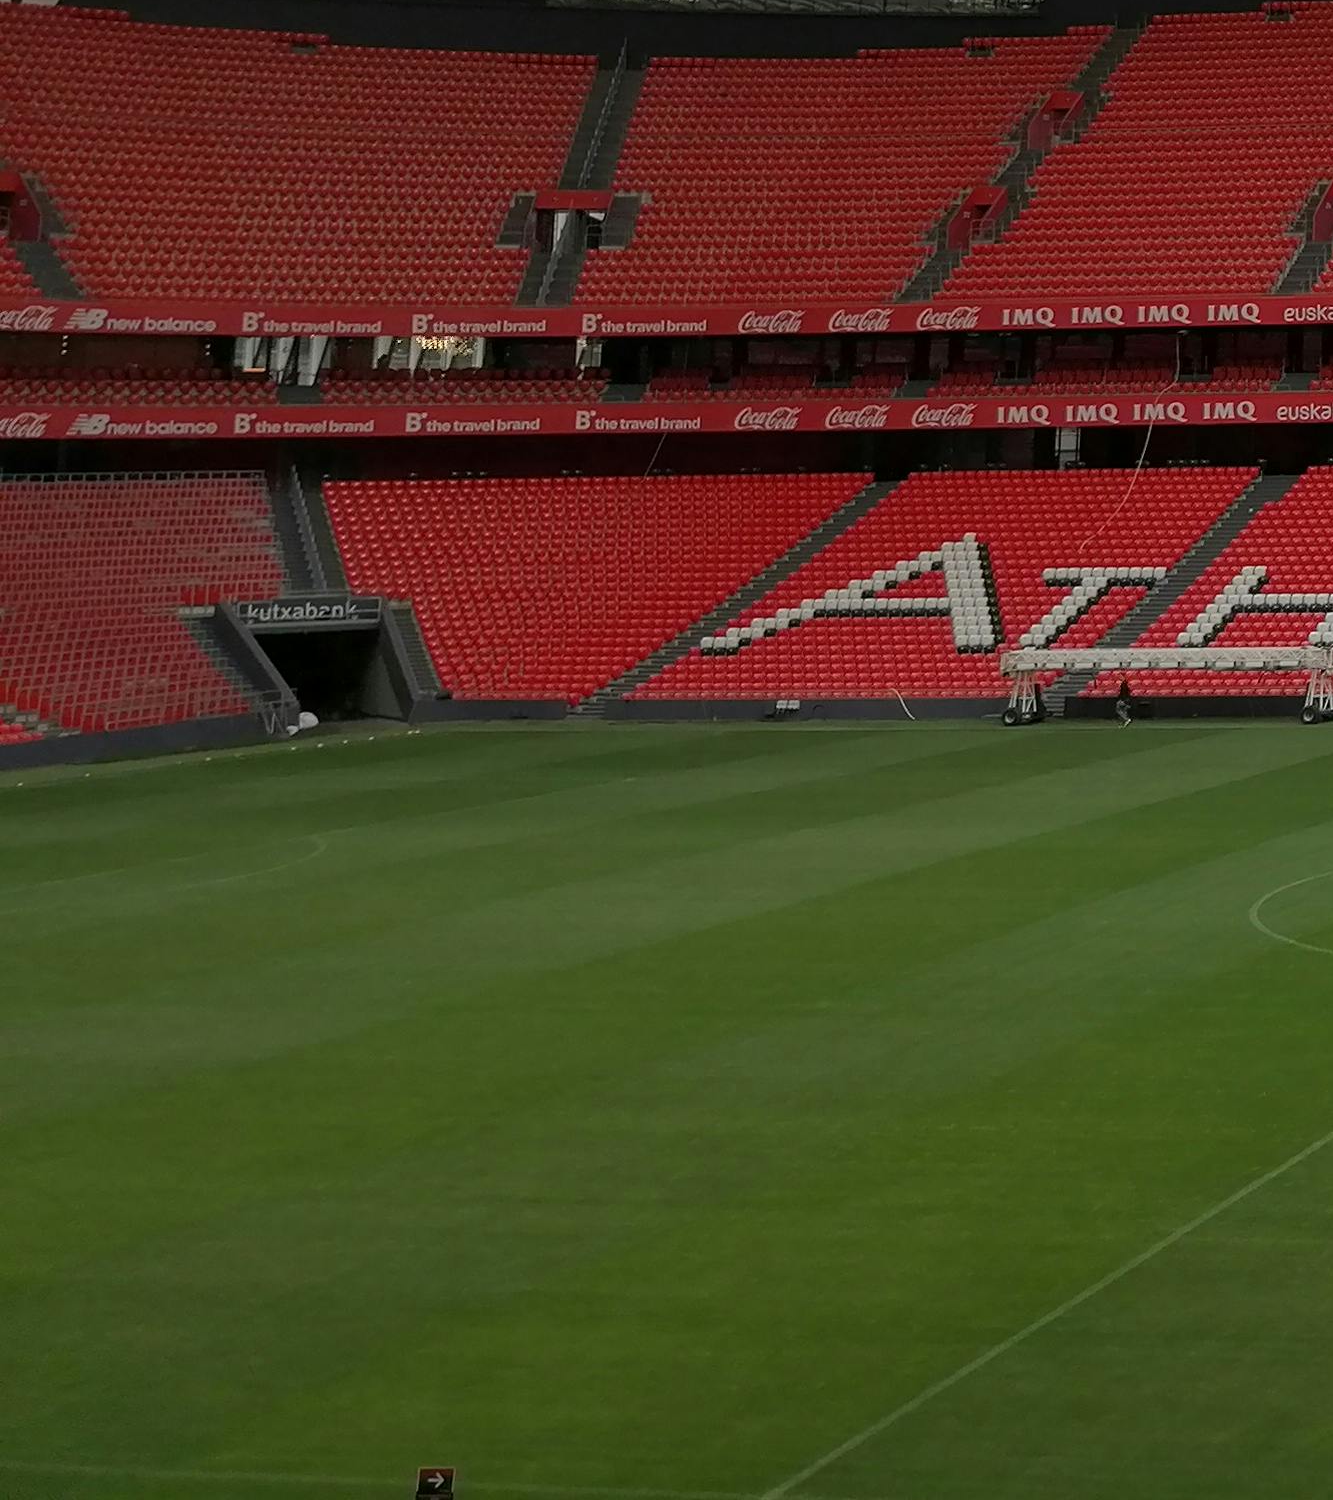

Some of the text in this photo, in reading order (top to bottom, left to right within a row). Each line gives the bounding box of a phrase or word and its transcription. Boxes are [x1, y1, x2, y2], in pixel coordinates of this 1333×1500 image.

[1002, 303, 1261, 327] IMQ IMQ IMQ IMQ
[107, 319, 141, 330] new
[144, 317, 216, 332] balance
[264, 320, 289, 332] the
[291, 321, 334, 333] travel
[336, 321, 381, 333] brand
[433, 321, 458, 333] the
[460, 321, 501, 333] travel
[503, 320, 546, 332] brand
[601, 321, 624, 332] the
[626, 320, 664, 332] travel
[667, 320, 706, 332] brand
[997, 401, 1257, 425] IMQ IMQ IMQ IMQ
[107, 423, 142, 435] new
[145, 420, 217, 435] balance
[255, 421, 281, 433] the
[283, 420, 327, 433] travel
[329, 420, 374, 432] brand
[426, 420, 451, 432] the
[453, 419, 494, 432] travel
[497, 418, 540, 431] brand
[595, 418, 618, 430] the
[620, 417, 658, 429] travel
[661, 417, 700, 429] brand
[246, 600, 358, 621] kutxabank
